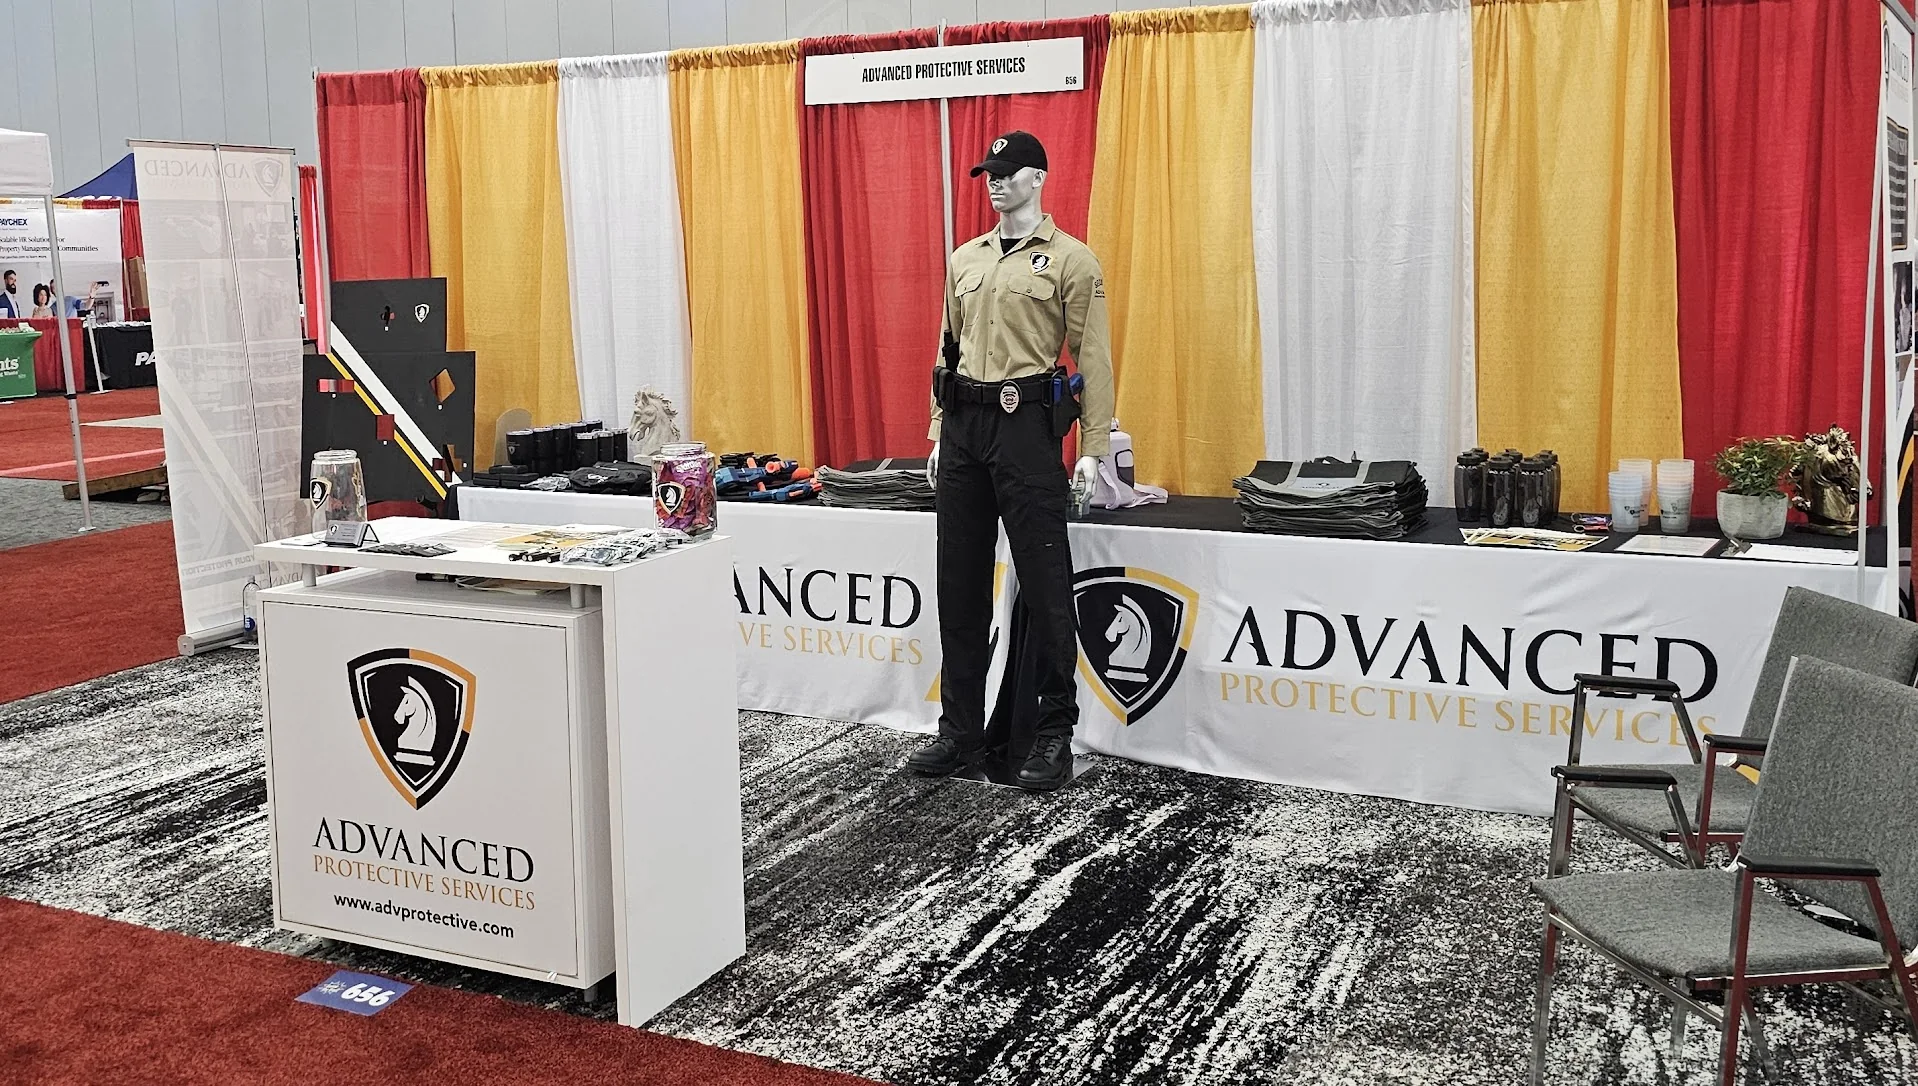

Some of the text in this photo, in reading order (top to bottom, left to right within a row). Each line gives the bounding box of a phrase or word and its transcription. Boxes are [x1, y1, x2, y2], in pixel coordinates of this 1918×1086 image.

[862, 57, 1026, 83] ADVANCED PROTECTIVE SERVICES
[1065, 76, 1077, 85] 656
[784, 625, 923, 665] SERVICES
[1221, 605, 1719, 703] ADVANCED
[1220, 671, 1478, 728] PROTECTIVE
[313, 817, 534, 883] ADVANCED
[313, 854, 535, 911] PROTECTIVE SERVICES
[333, 892, 514, 938] www.advprotective.com
[341, 983, 395, 1006] 656
